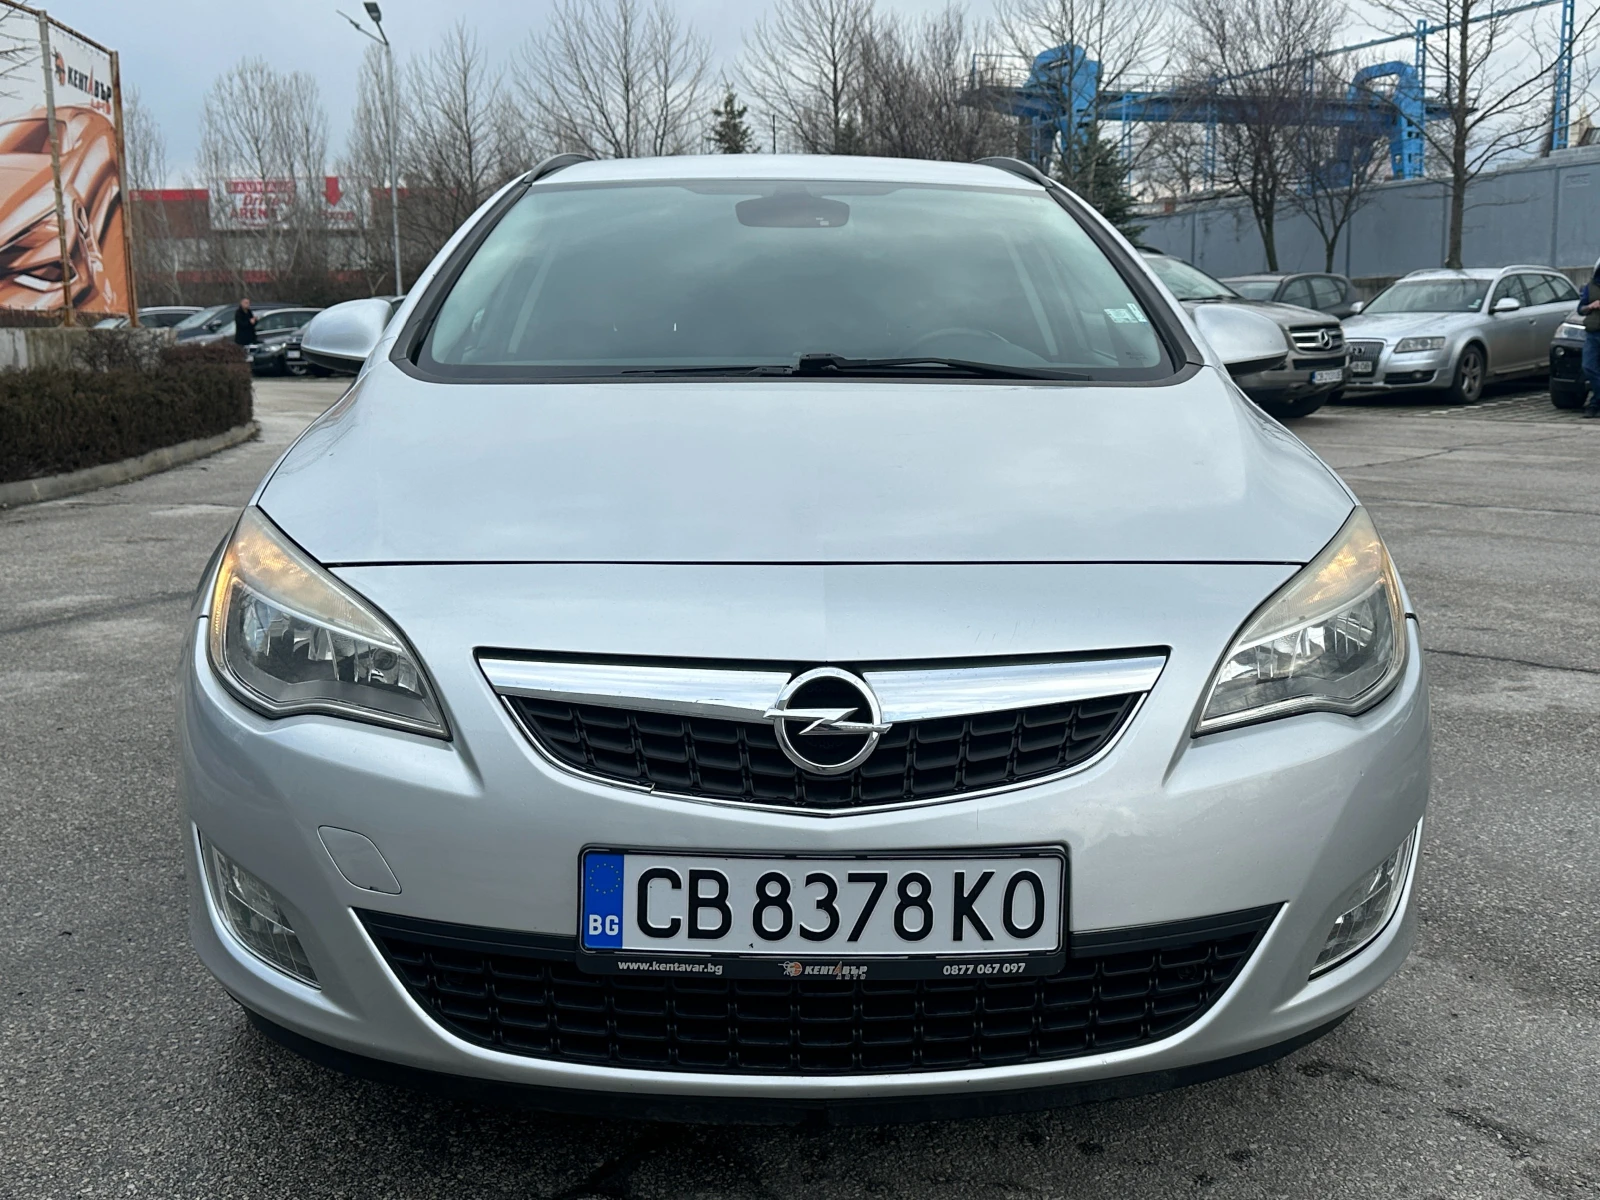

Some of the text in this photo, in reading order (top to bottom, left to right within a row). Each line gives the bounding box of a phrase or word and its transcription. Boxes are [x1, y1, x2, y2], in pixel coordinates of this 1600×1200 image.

[636, 867, 1045, 942] CB 8378 KO
[588, 914, 619, 936] BG
[617, 961, 723, 975] www.kentavar.bg
[804, 960, 868, 976] КЕНТАВЪР
[943, 962, 1026, 975] 0877 067 097
